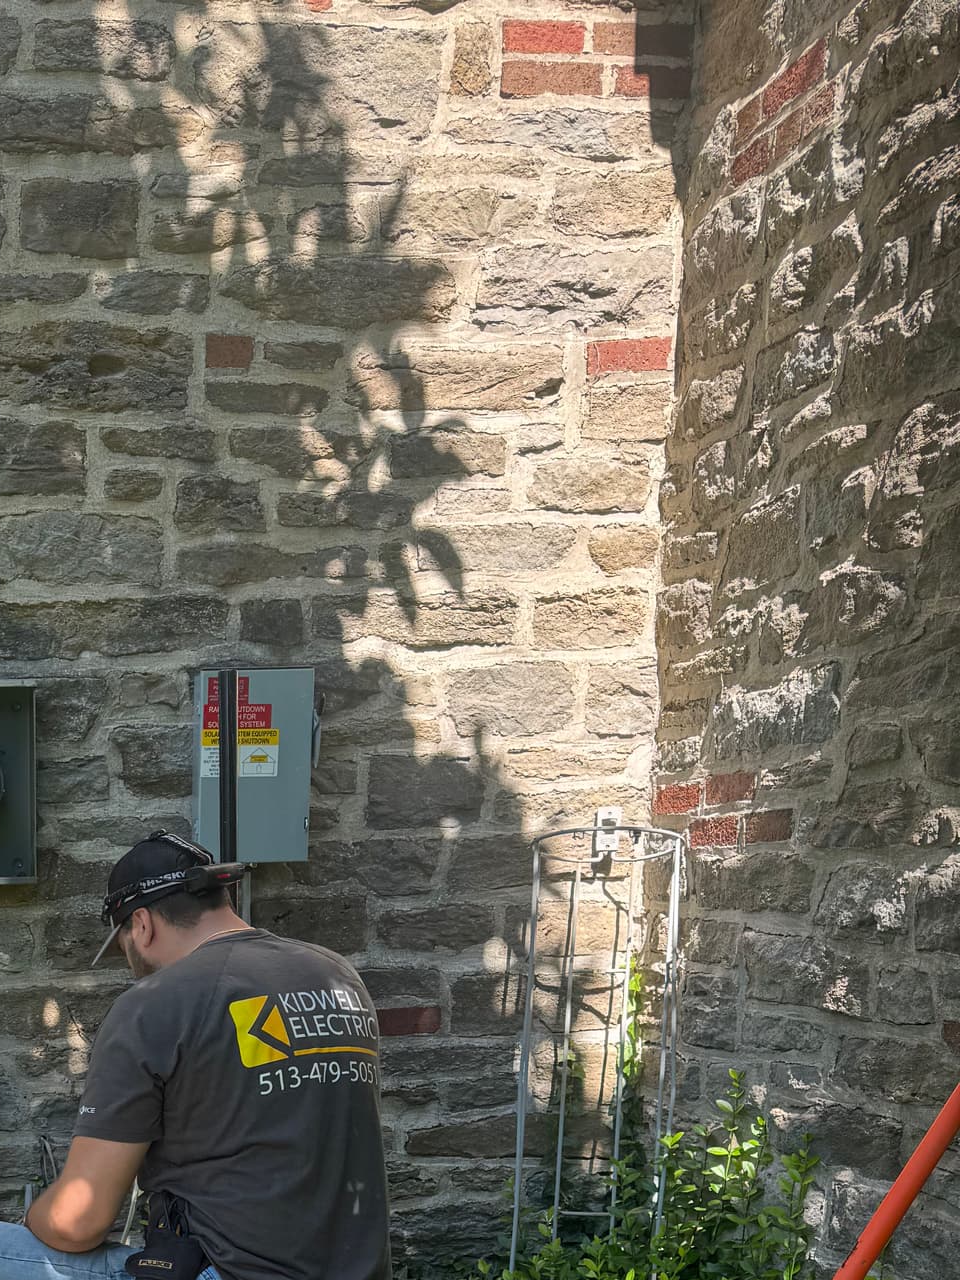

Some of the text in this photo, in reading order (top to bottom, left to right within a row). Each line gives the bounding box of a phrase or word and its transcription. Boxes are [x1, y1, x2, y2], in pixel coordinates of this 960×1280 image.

[147, 871, 186, 887] HUSKY
[278, 989, 369, 1014] KIDWELL
[289, 1013, 377, 1040] ELECTRIC
